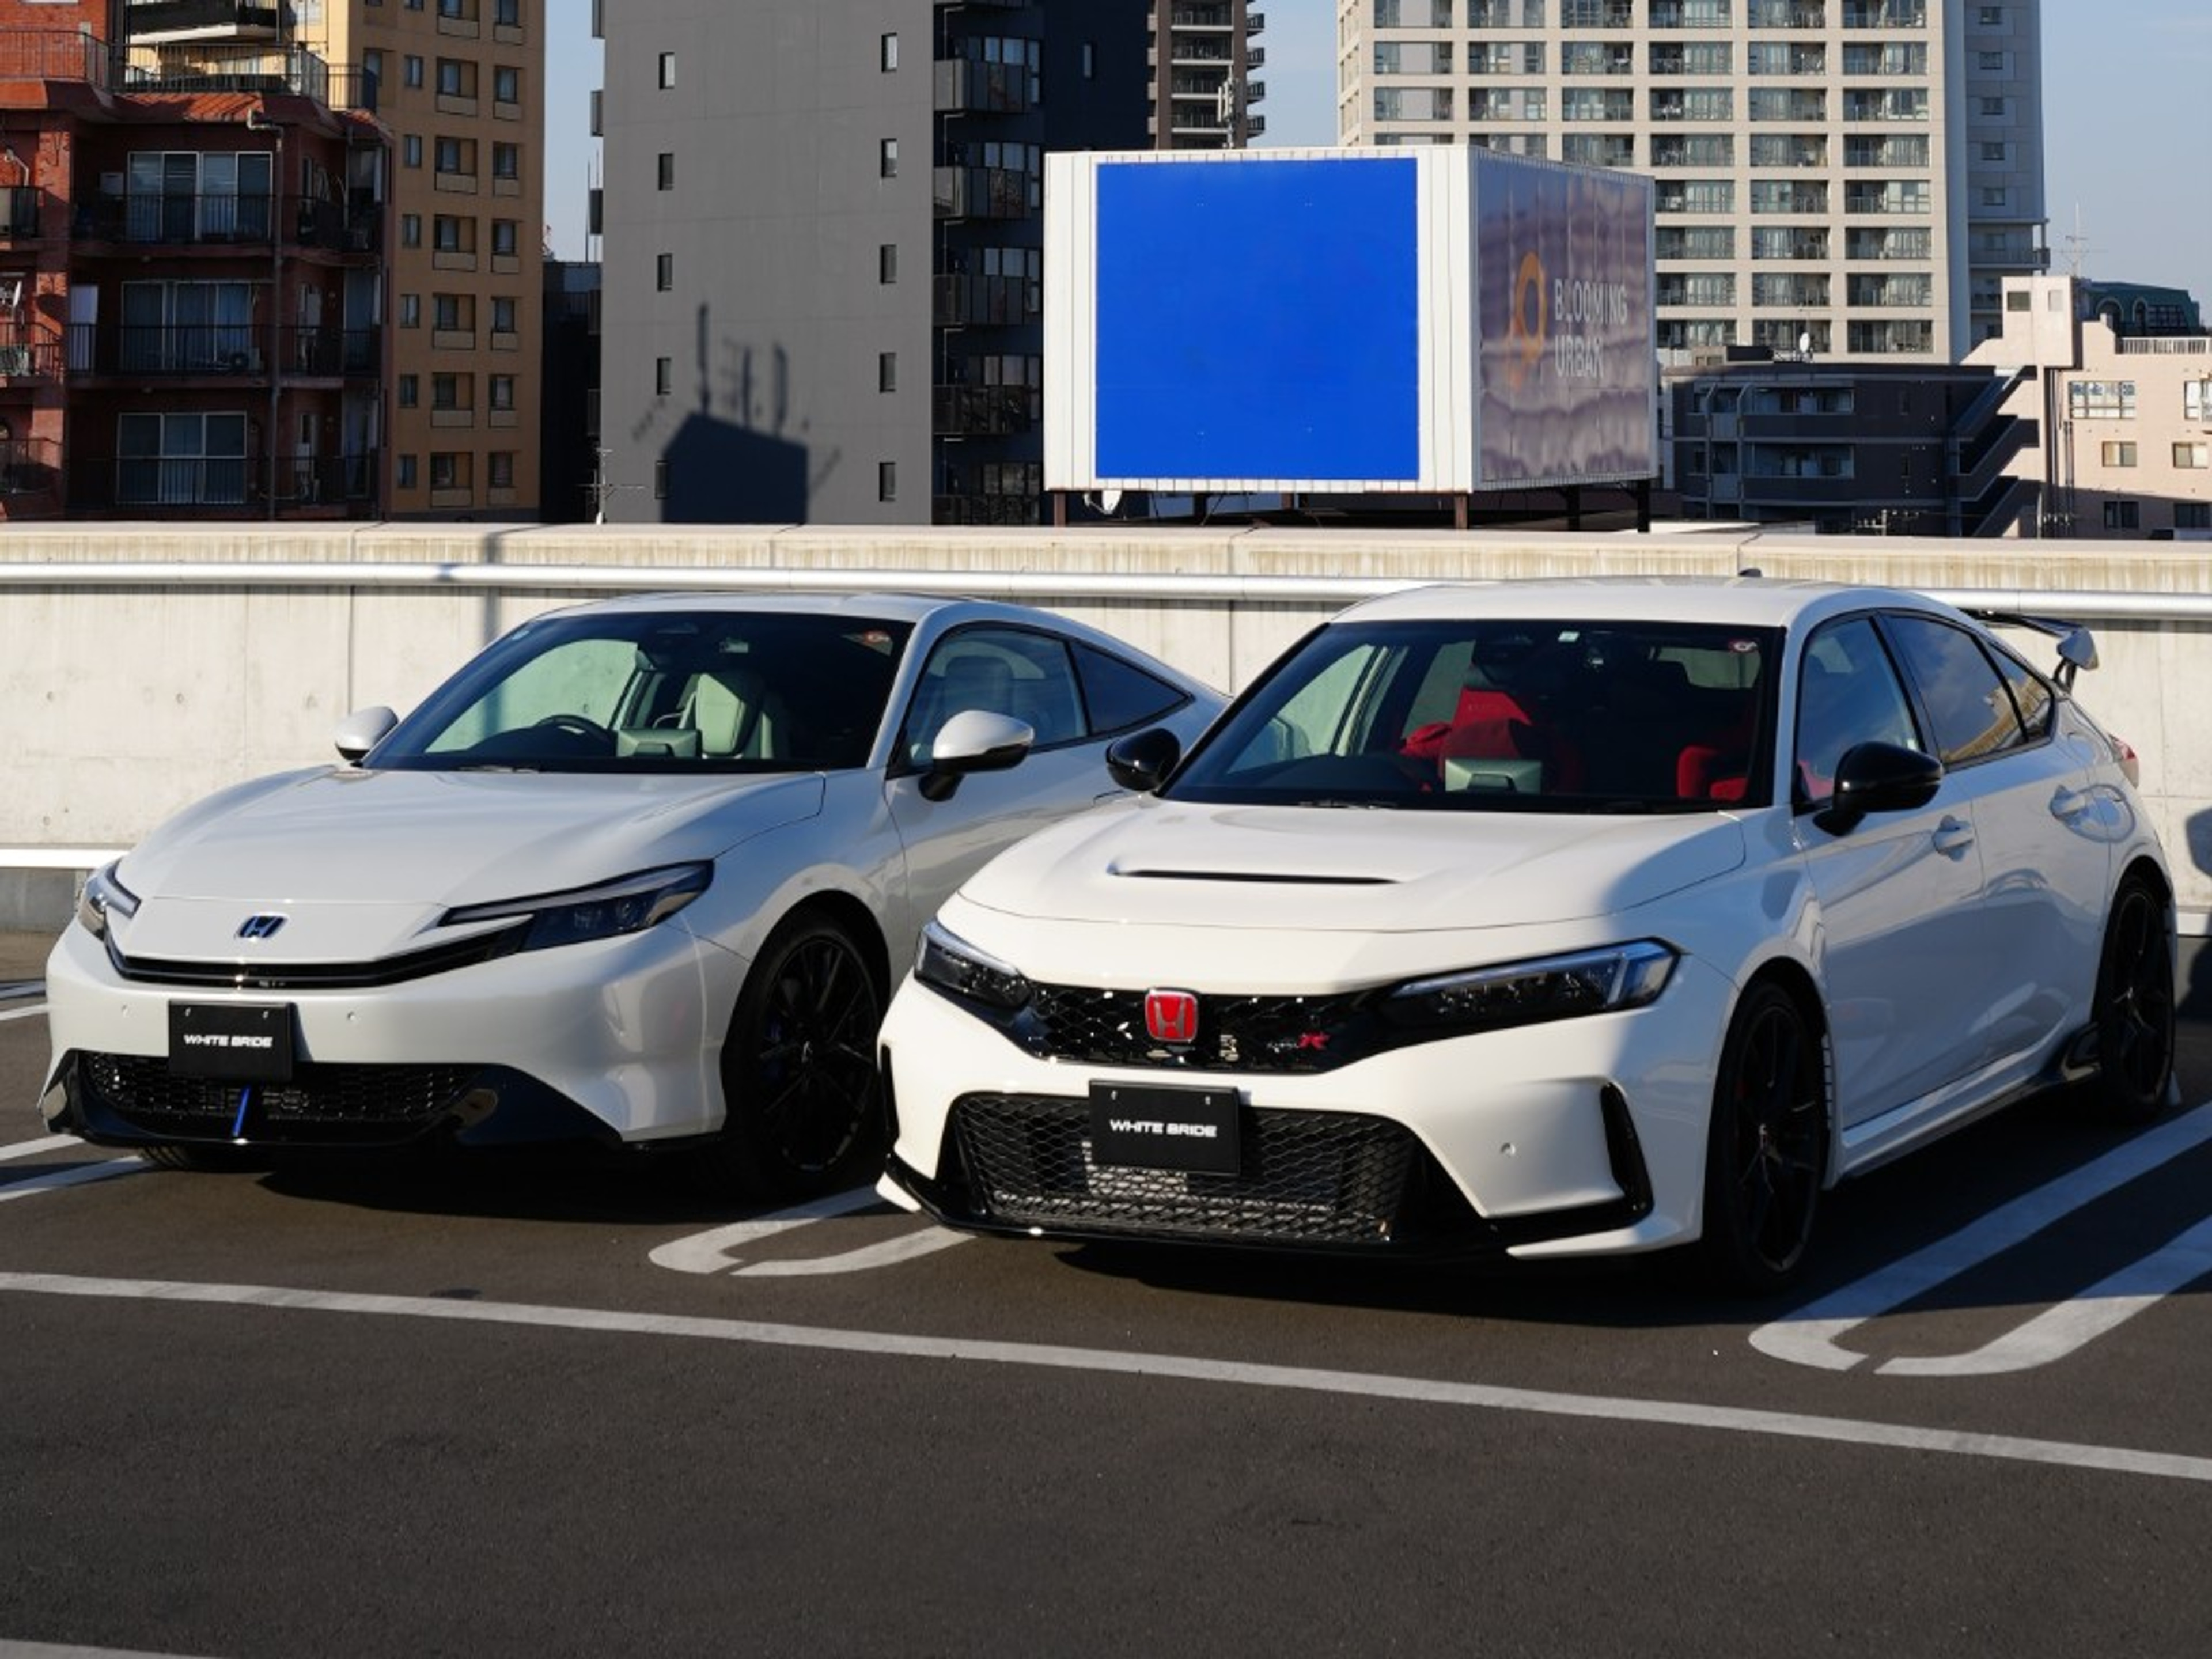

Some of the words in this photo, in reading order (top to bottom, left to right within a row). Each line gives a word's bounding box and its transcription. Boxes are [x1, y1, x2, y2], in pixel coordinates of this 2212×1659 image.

[1555, 278, 1628, 326] BLOOMING
[1555, 335, 1604, 378] URBAN
[183, 1034, 229, 1047] WHITE
[230, 1036, 273, 1048] BRIDE
[1109, 1119, 1164, 1134] WHITE
[1166, 1123, 1217, 1138] BRIDE
